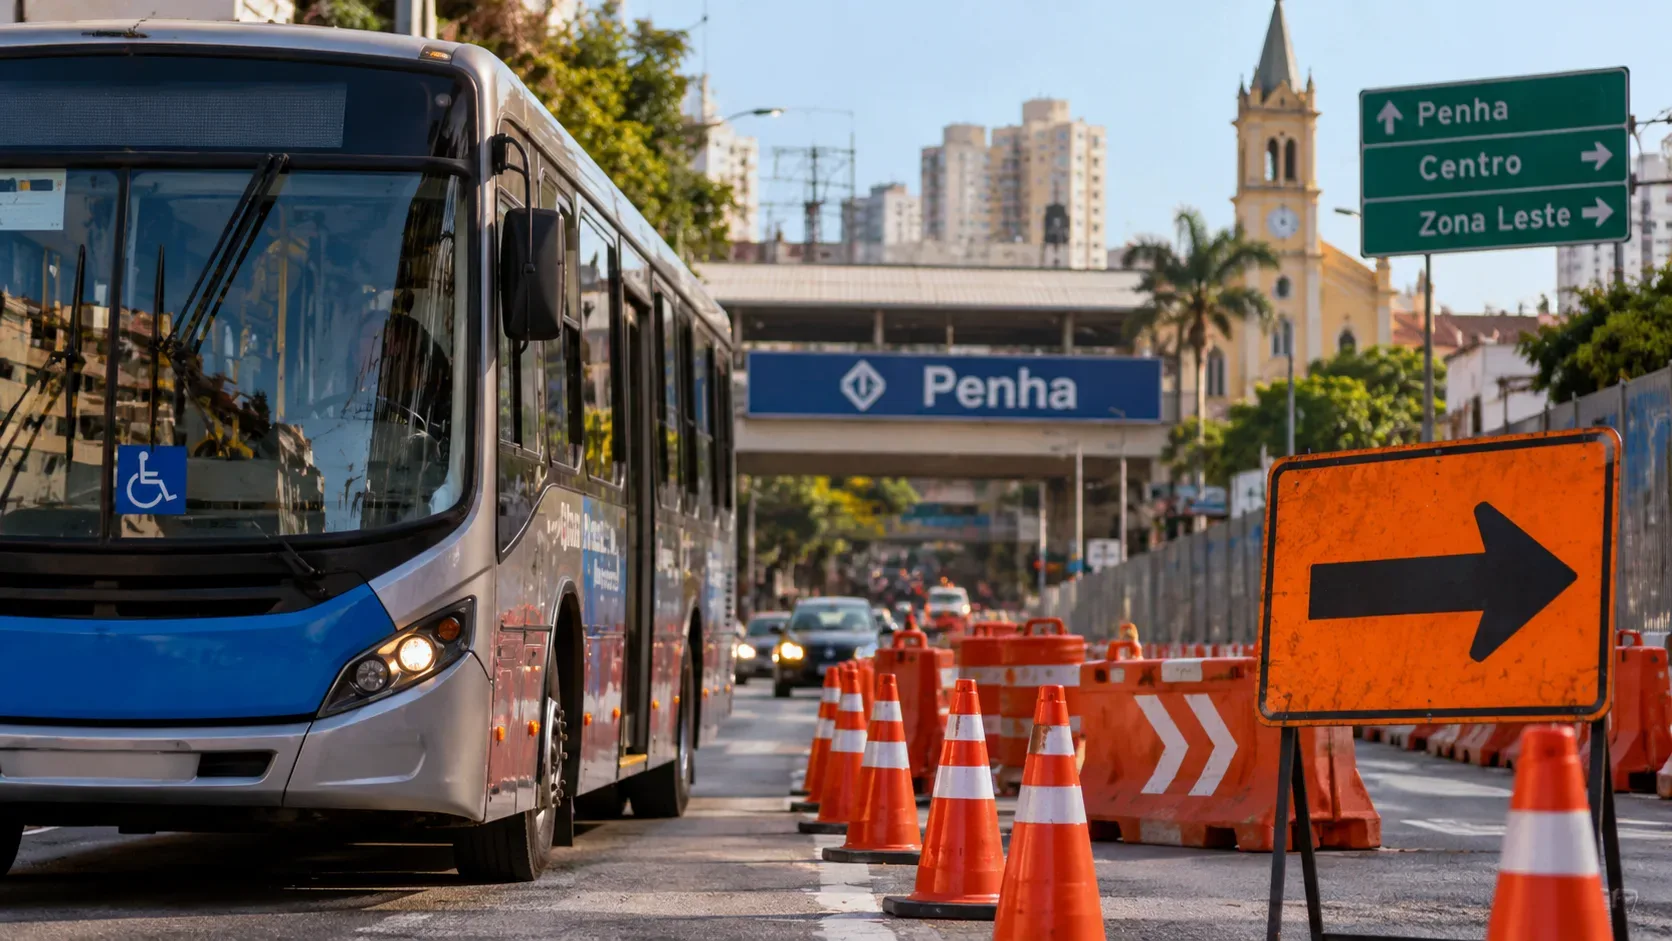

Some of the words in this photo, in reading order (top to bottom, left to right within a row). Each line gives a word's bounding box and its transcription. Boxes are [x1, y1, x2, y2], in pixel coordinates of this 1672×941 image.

[1417, 97, 1509, 127] Penha
[1419, 152, 1522, 181] Centro
[1419, 210, 1486, 237] Zona
[1498, 203, 1571, 231] Leste
[923, 365, 1077, 410] Penha
